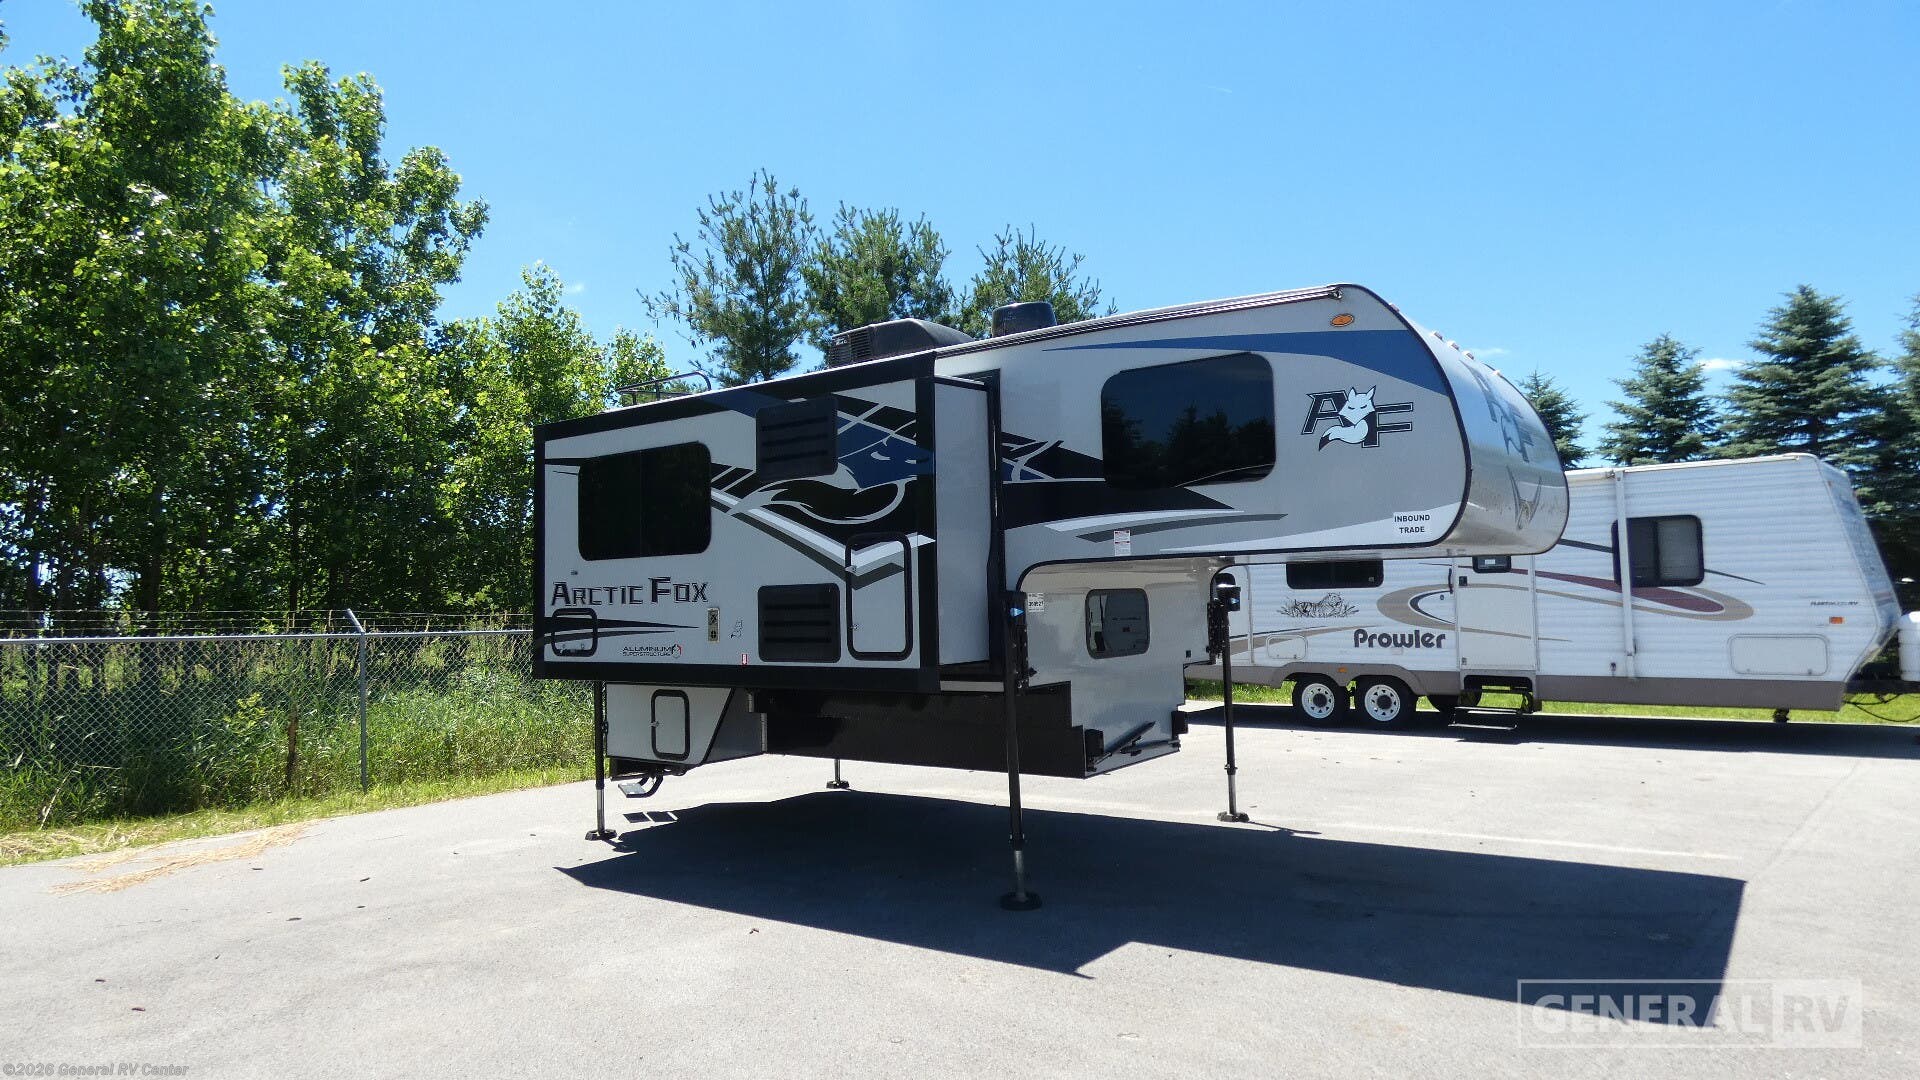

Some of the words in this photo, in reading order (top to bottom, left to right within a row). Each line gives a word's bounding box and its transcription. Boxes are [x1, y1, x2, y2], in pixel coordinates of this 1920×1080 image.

[1394, 514, 1431, 523] INBOUND
[1399, 526, 1425, 534] TRADE
[1353, 628, 1447, 649] Prowler
